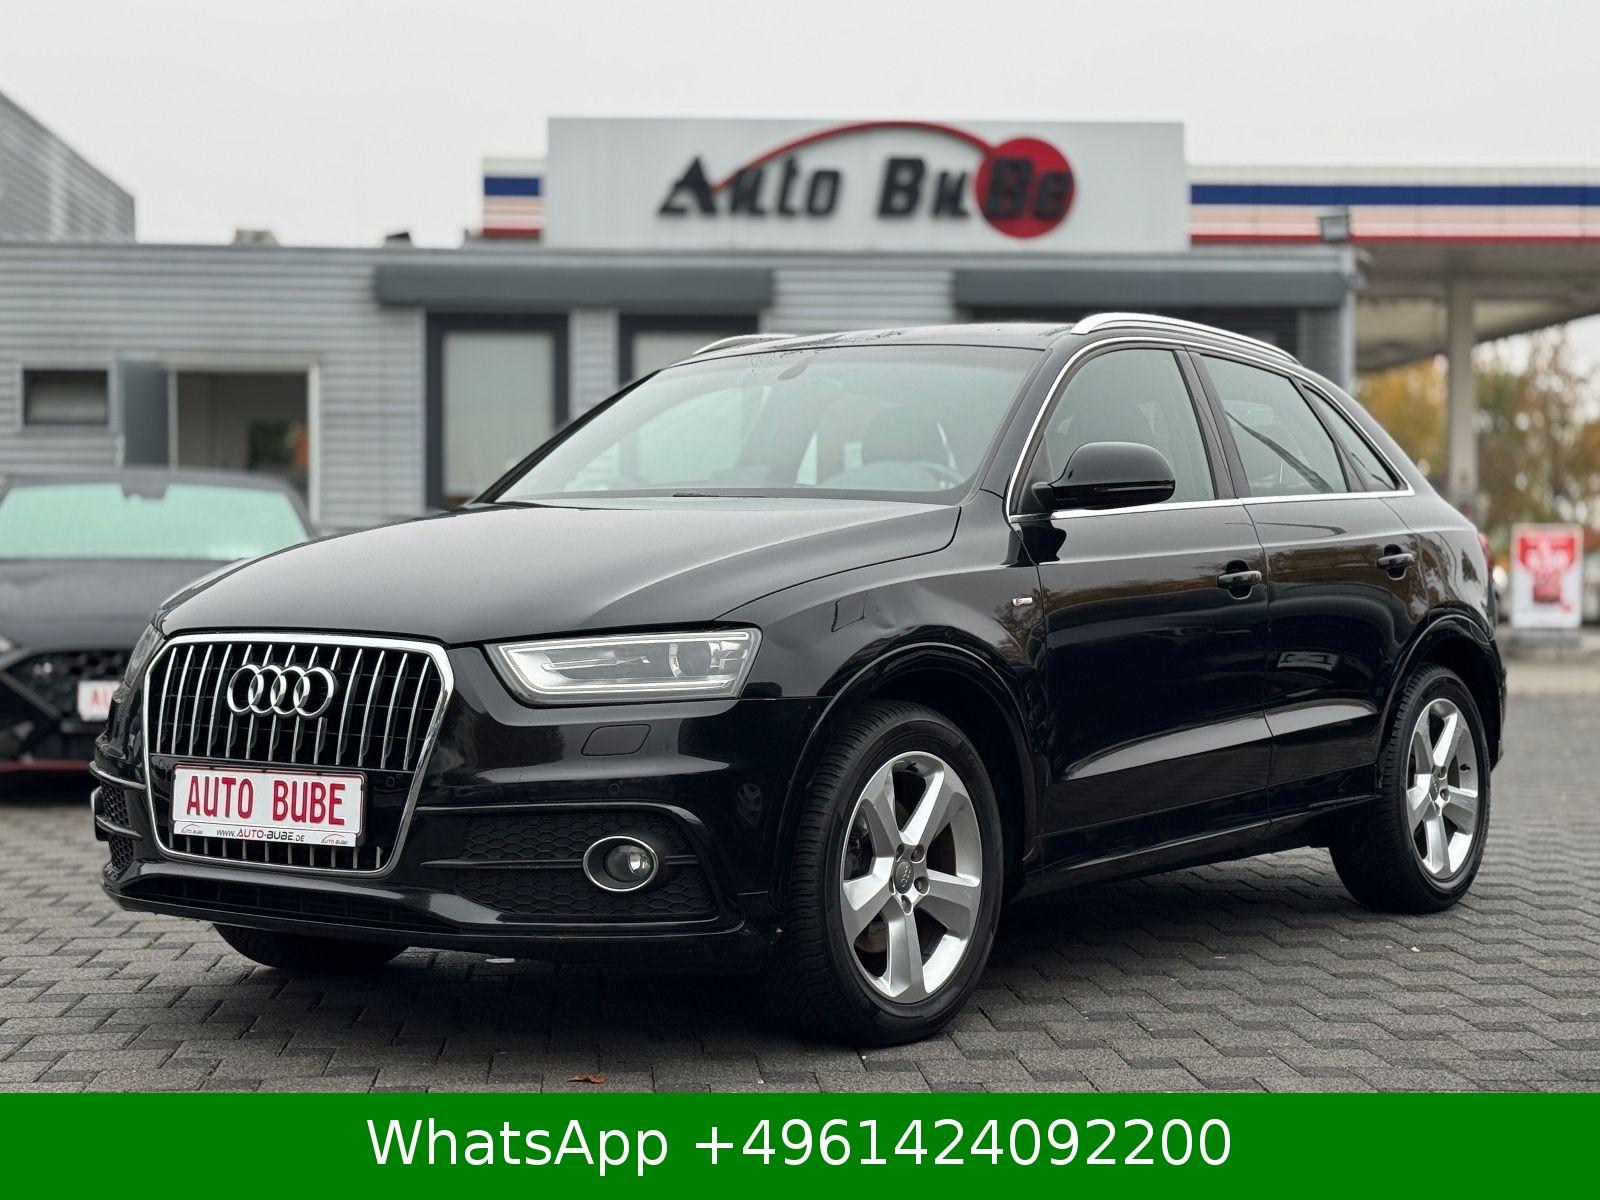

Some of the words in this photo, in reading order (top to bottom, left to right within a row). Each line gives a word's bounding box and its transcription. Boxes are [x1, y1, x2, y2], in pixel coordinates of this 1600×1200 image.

[657, 154, 842, 219] Auto
[186, 775, 254, 819] AUTO
[272, 780, 346, 826] BUBE
